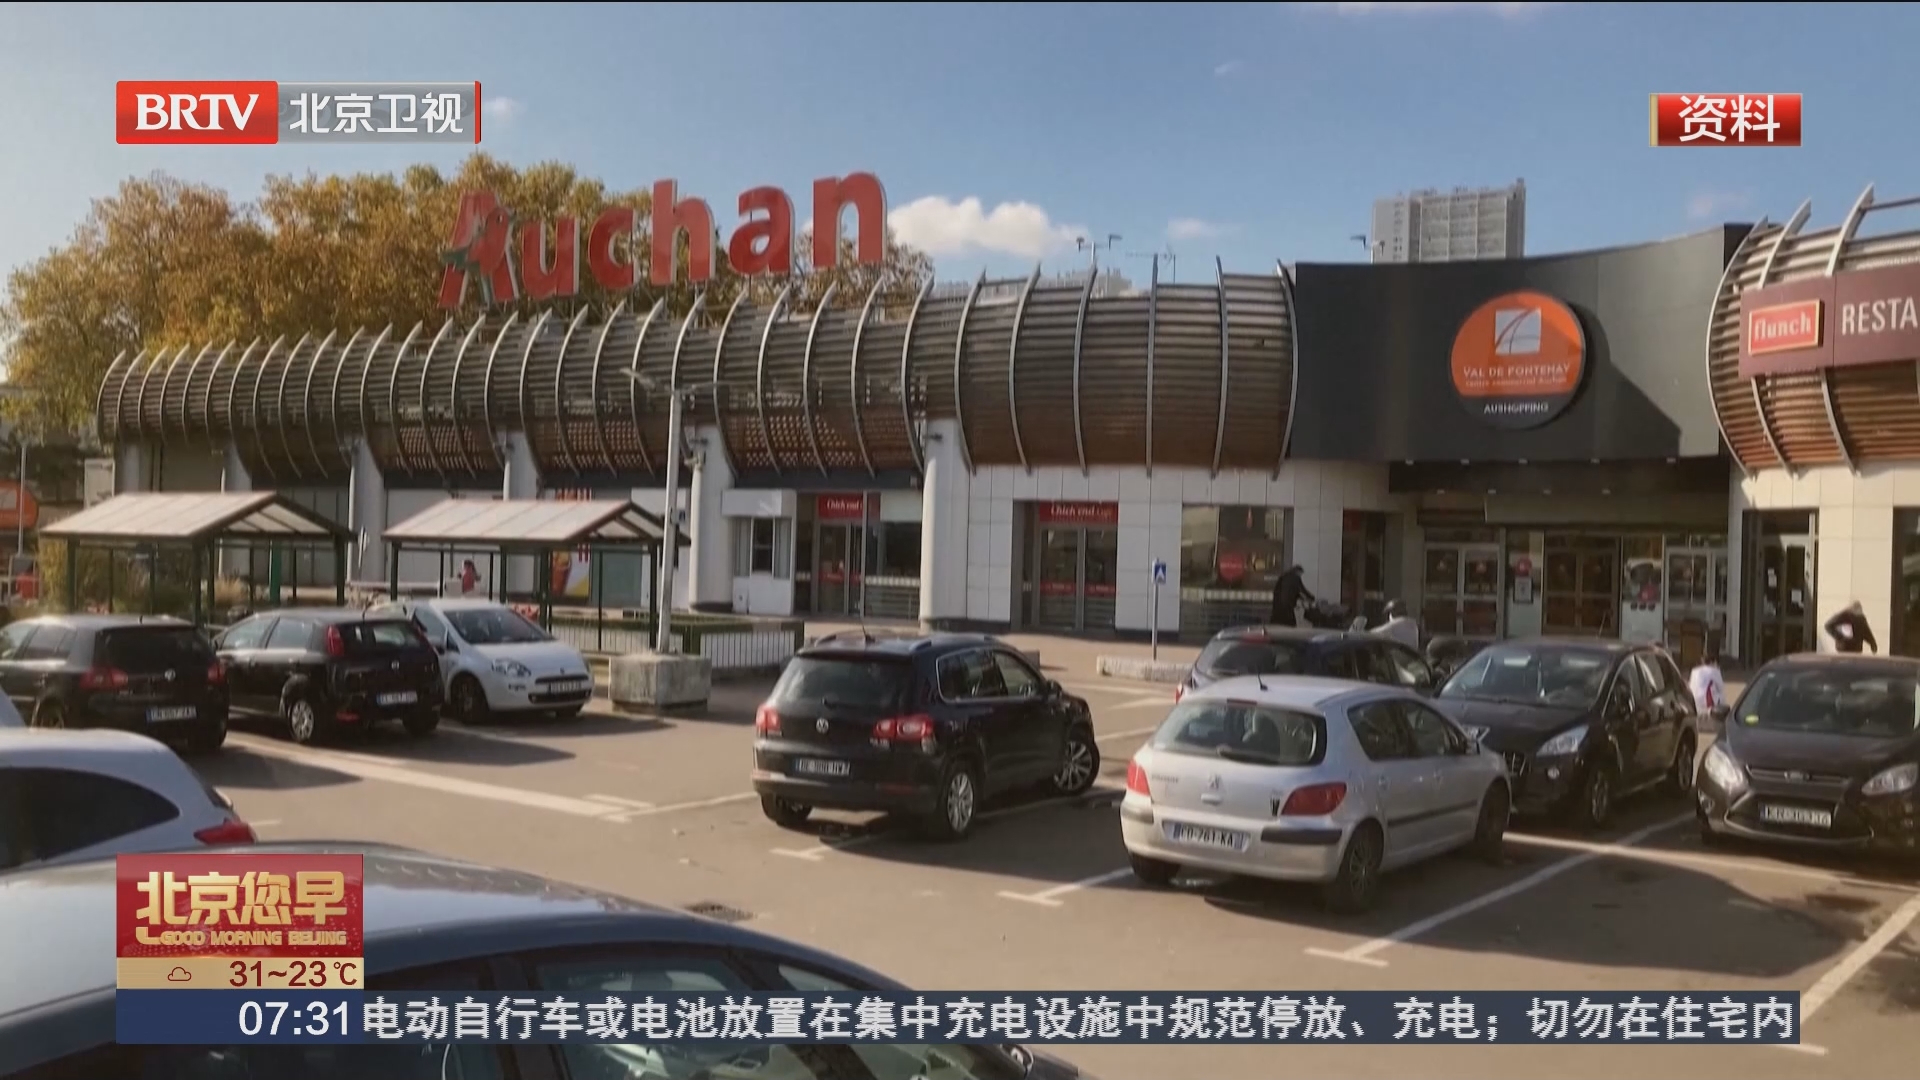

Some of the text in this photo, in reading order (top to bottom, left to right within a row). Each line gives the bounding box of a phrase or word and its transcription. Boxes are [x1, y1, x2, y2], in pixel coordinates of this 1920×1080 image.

[438, 171, 886, 308] Auchan
[1754, 315, 1812, 341] flunch
[1841, 297, 1919, 336] RESTA
[1463, 366, 1485, 378] VAL
[1489, 367, 1504, 377] DE
